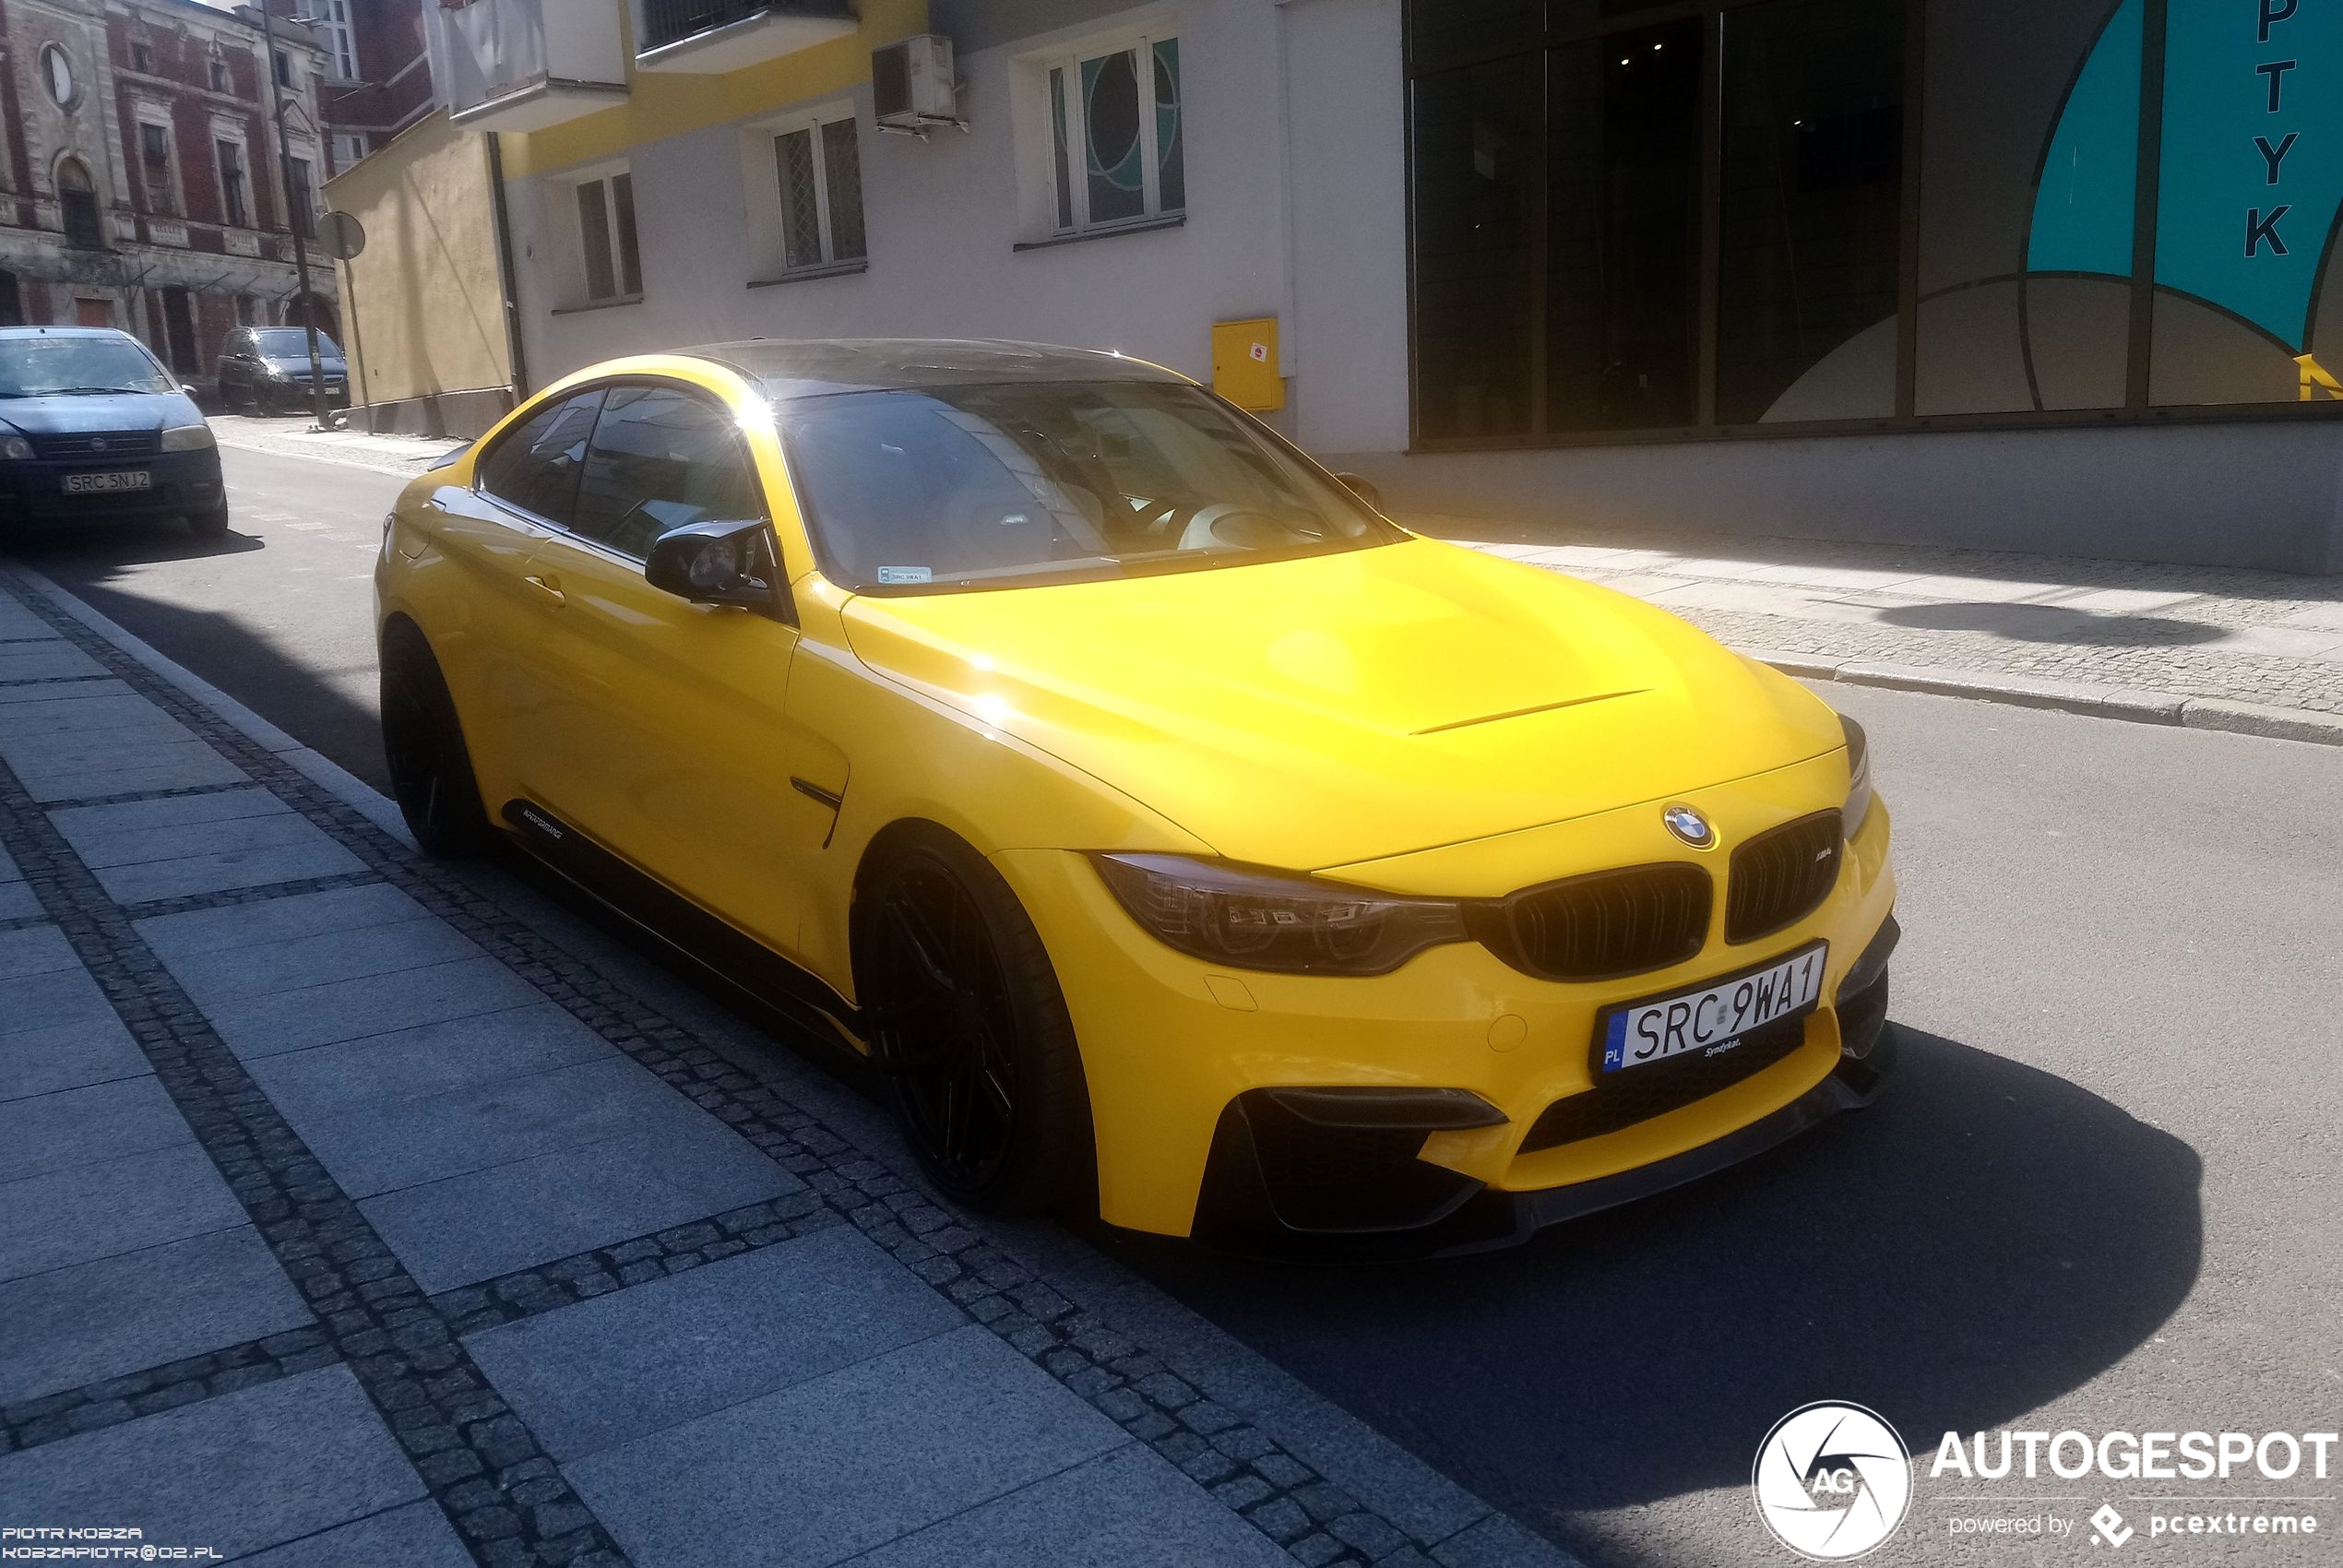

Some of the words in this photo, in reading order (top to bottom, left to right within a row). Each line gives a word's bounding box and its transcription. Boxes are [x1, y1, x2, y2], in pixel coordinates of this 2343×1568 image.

[70, 475, 104, 491] SRC
[1605, 1050, 1621, 1064] PL
[1634, 993, 1719, 1060] SRC
[1730, 955, 1814, 1033] 9WA1
